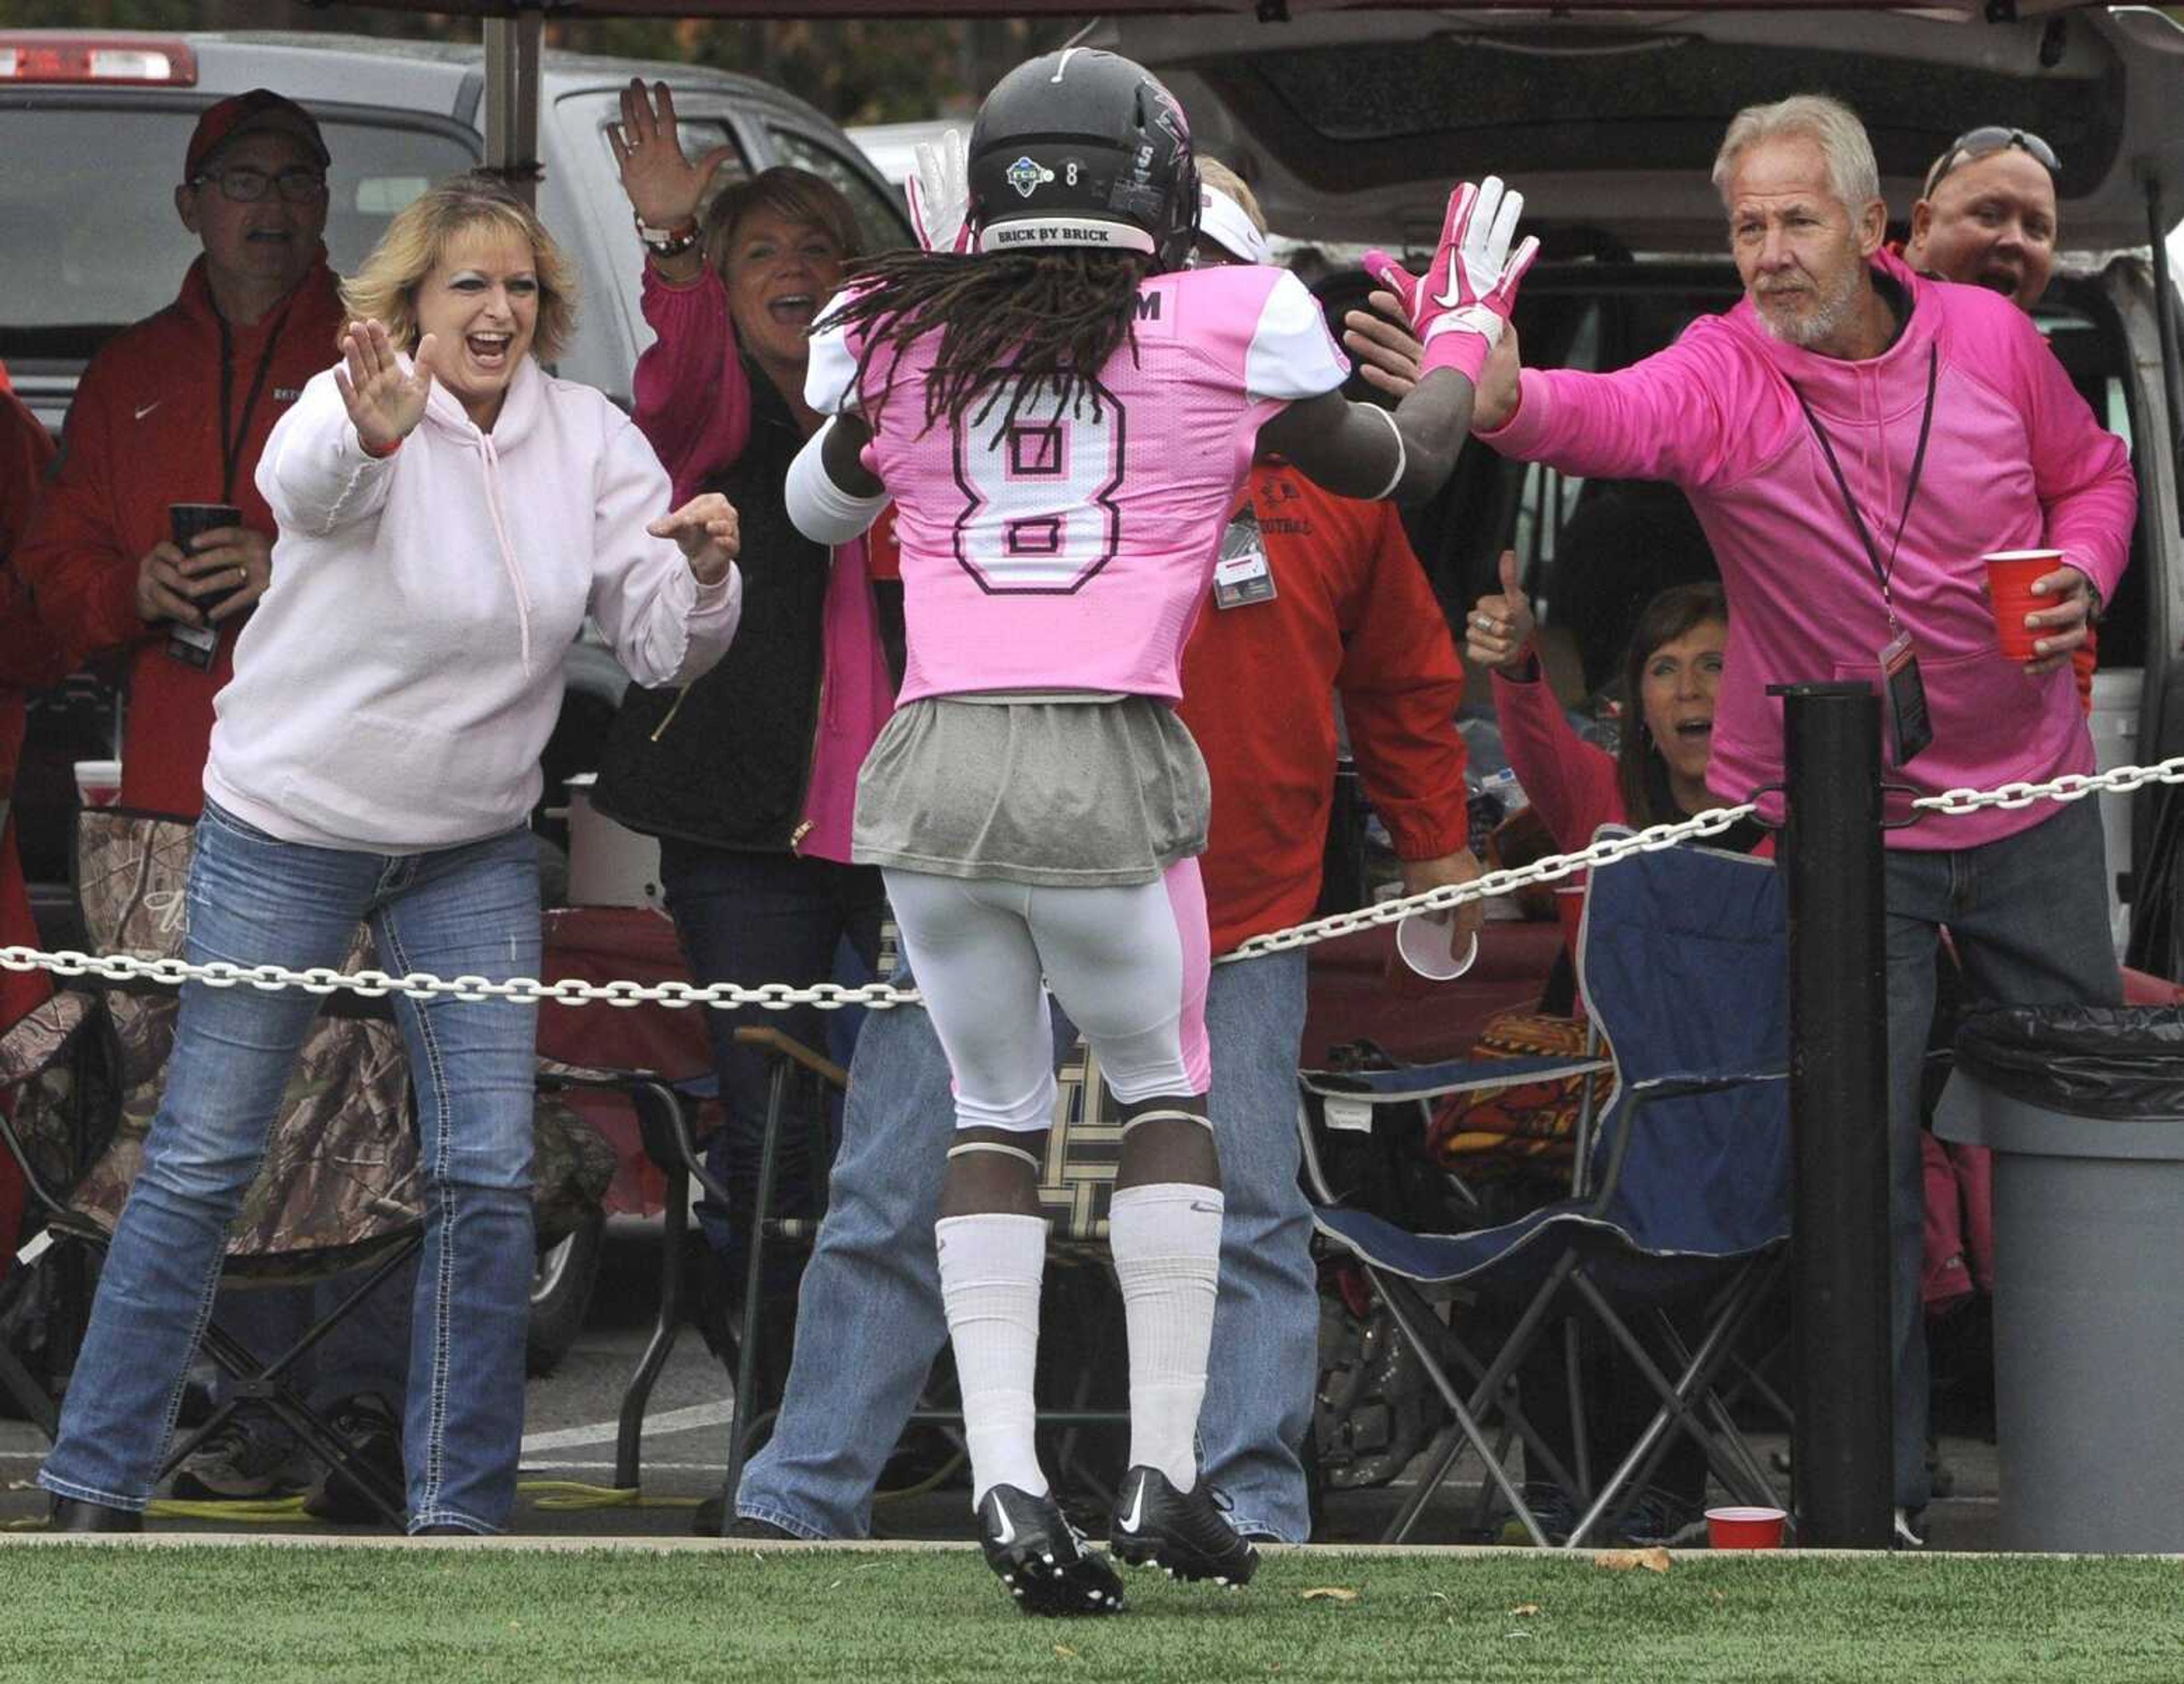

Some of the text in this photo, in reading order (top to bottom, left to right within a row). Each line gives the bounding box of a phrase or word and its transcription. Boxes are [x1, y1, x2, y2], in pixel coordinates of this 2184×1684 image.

[1066, 163, 1077, 186] 8
[998, 227, 1109, 243] BRICK BY BRICK
[953, 366, 1126, 595] 8
